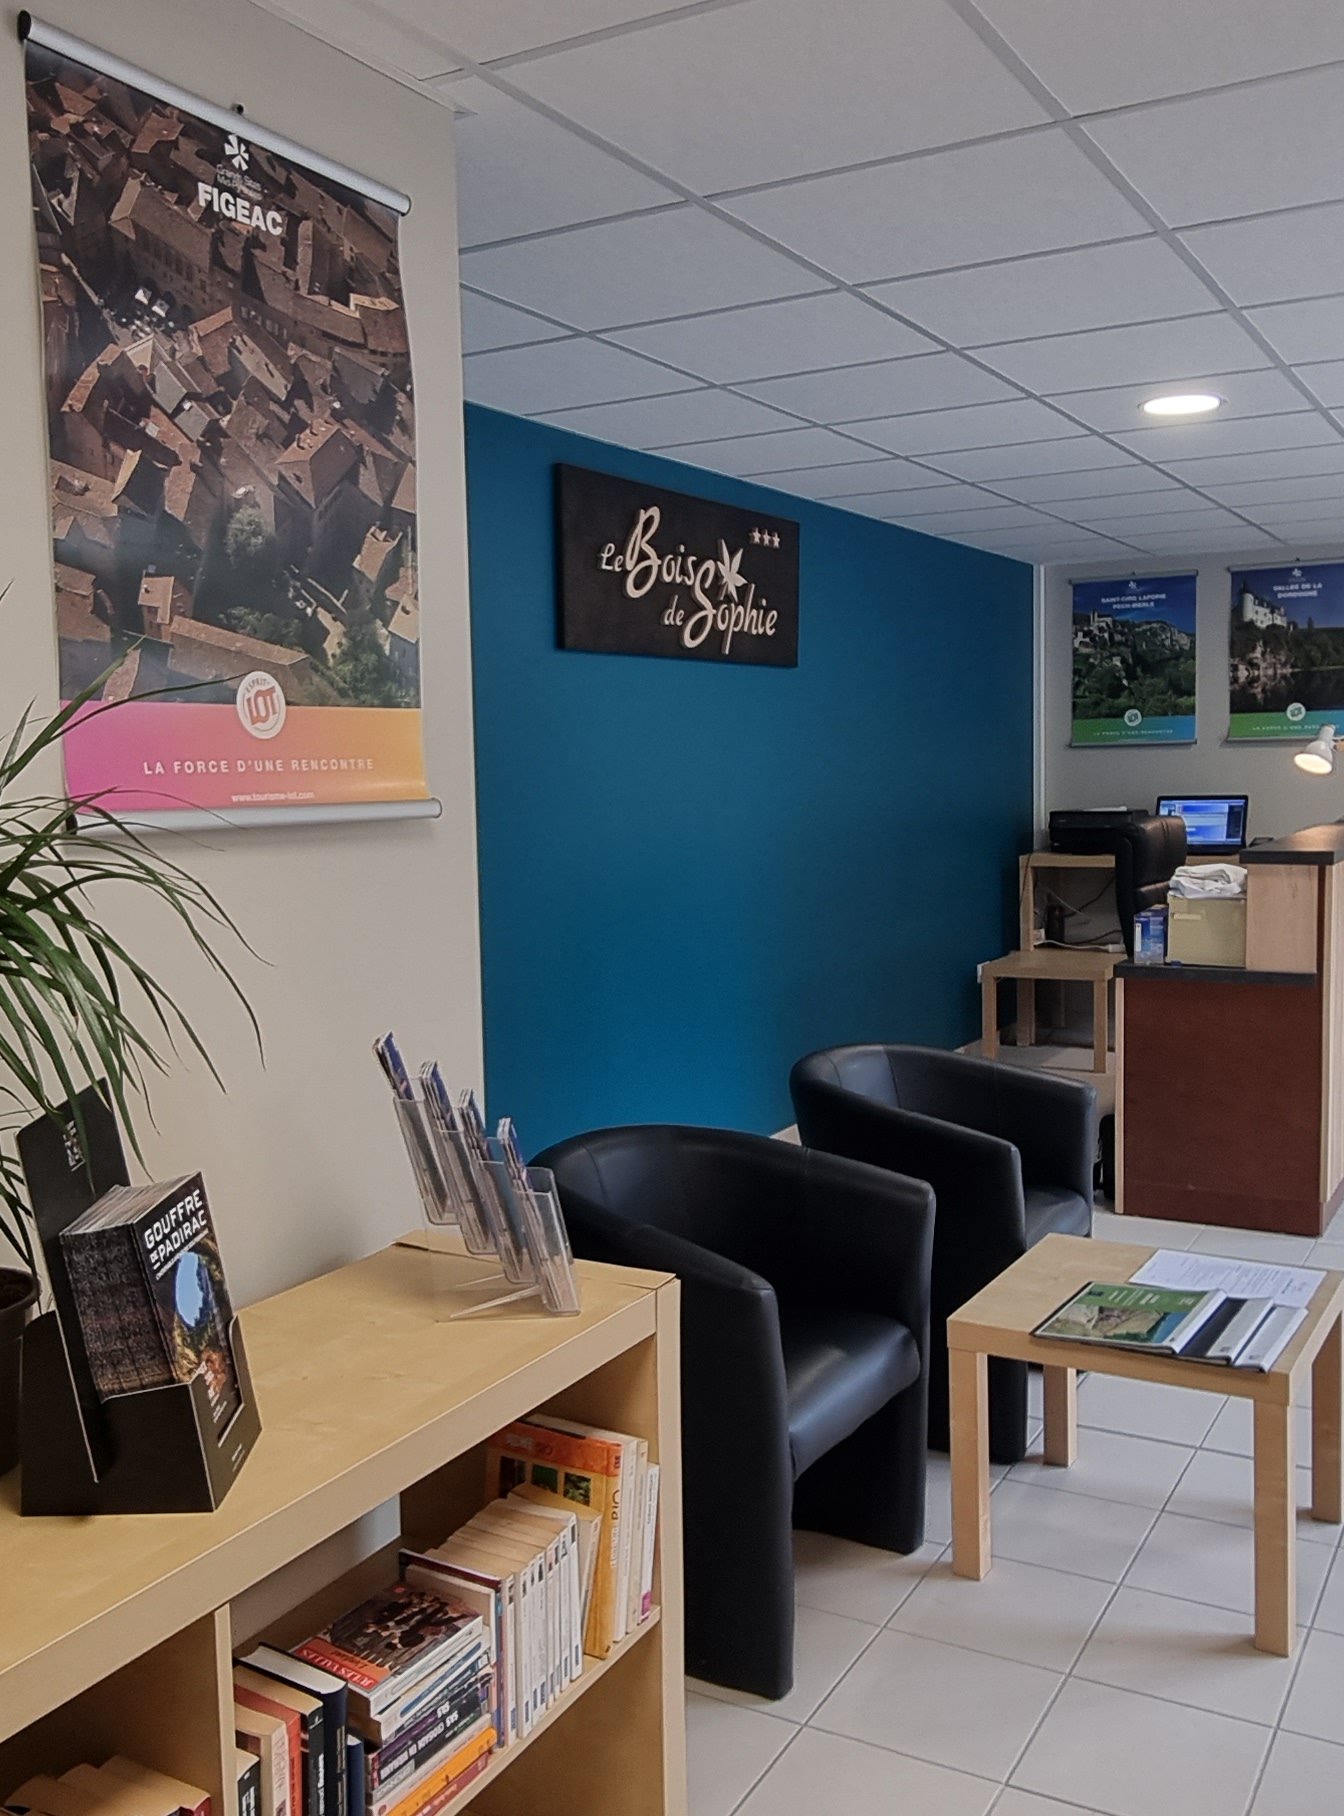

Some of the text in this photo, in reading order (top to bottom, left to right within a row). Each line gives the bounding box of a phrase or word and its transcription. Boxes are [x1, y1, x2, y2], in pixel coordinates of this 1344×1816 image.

[197, 181, 283, 236] FIGEAC
[600, 505, 697, 599] Le Bois
[663, 559, 778, 655] de Sophie
[246, 686, 277, 726] LOT
[143, 758, 374, 775] LA FORCE D'UNE RENCONTRE
[144, 1189, 203, 1250] GOUFFRE
[157, 1209, 207, 1262] PADIRAC
[341, 1668, 374, 1687] JULES
